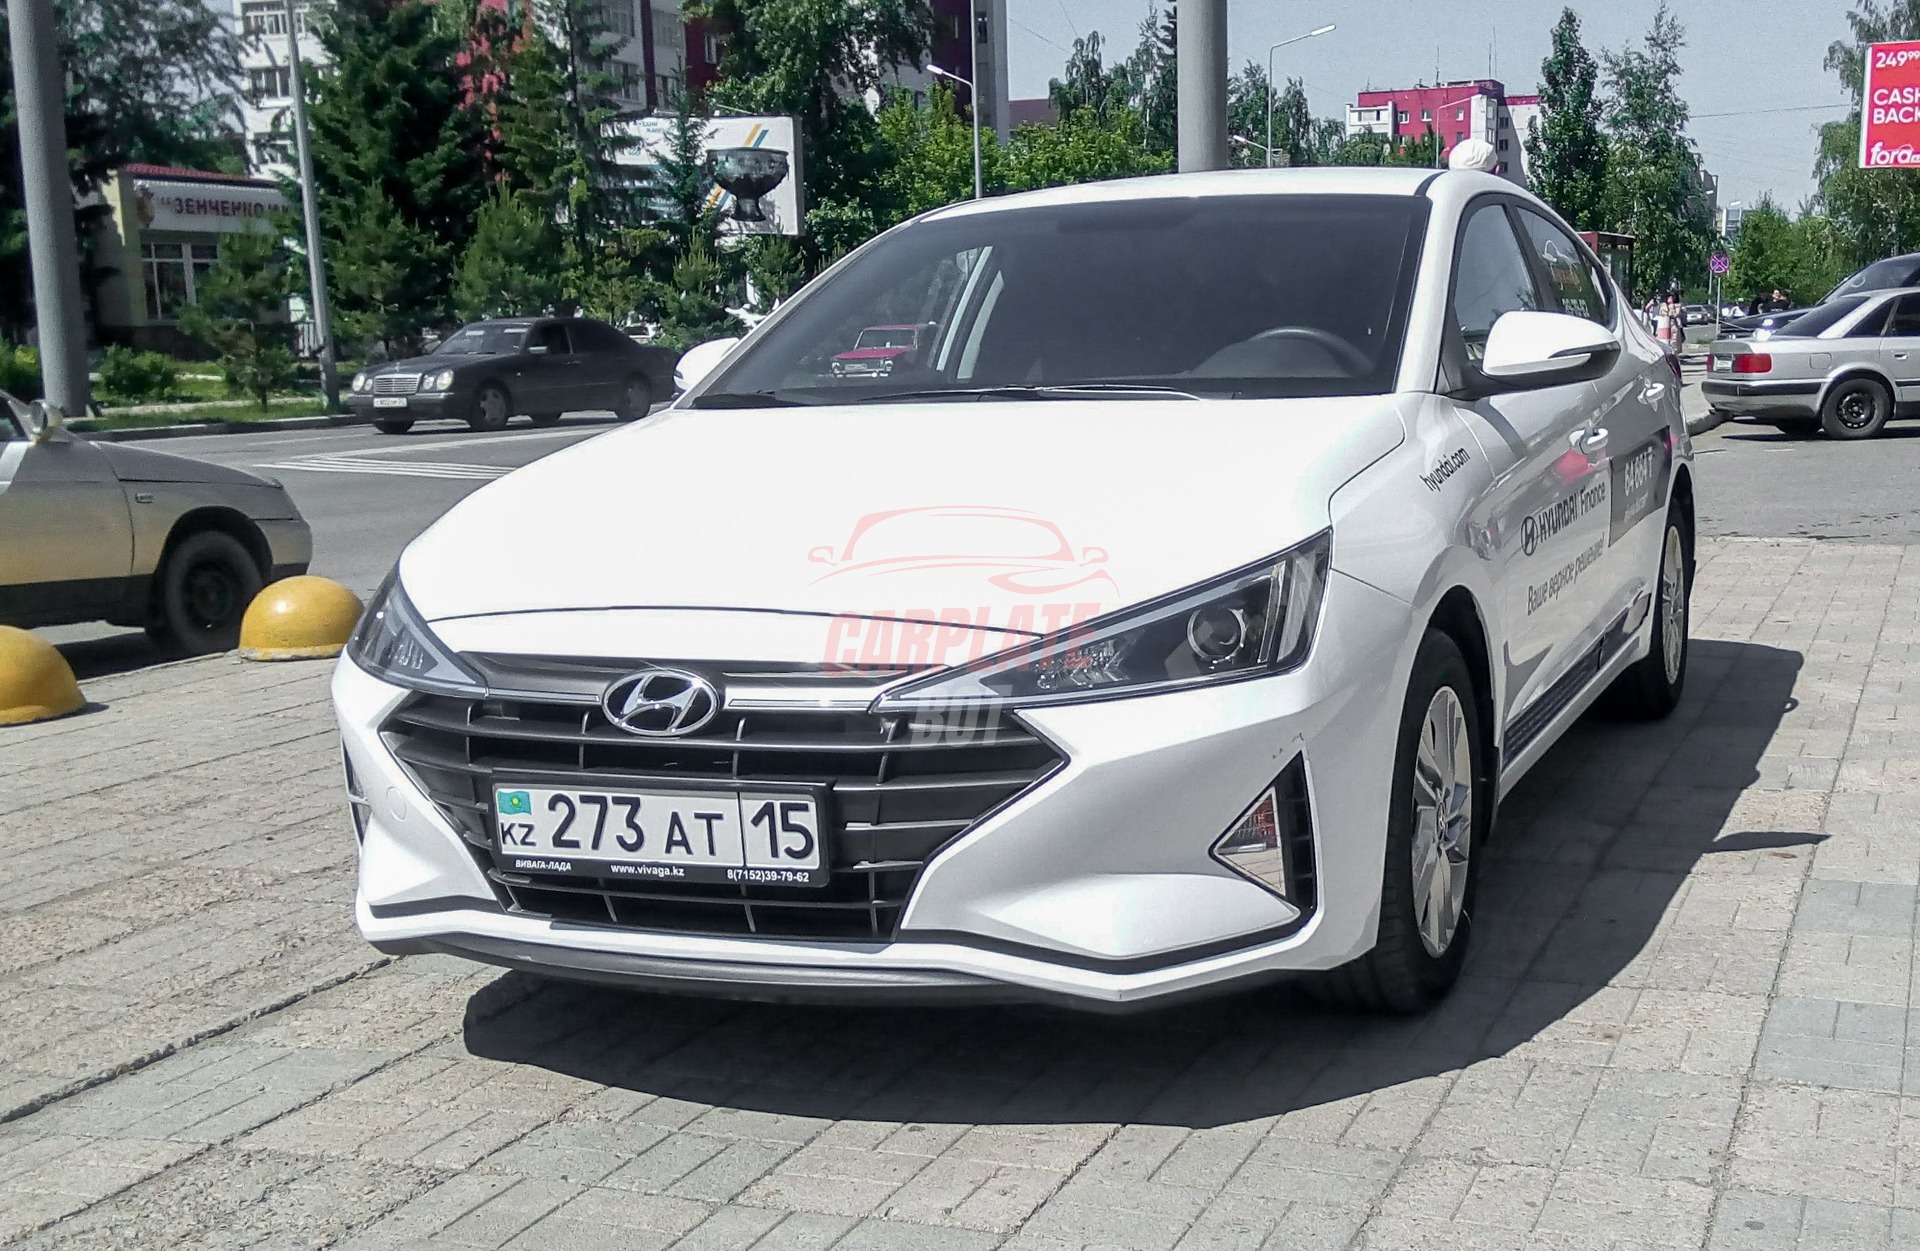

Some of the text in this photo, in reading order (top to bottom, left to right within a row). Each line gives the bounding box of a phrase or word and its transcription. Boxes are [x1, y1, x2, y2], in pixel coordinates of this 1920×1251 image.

[1870, 141, 1914, 165] fora
[1419, 447, 1470, 492] hyundai.com
[1538, 492, 1578, 543] HYUNDAI
[1579, 481, 1606, 515] Finance
[500, 822, 537, 847] KZ
[547, 793, 815, 860] 273 AT 15
[515, 859, 572, 871] ВИВАГА-ЛАДА
[610, 864, 685, 877] www.vivaga.kz
[727, 869, 809, 883] 8(7152)39-79-62
